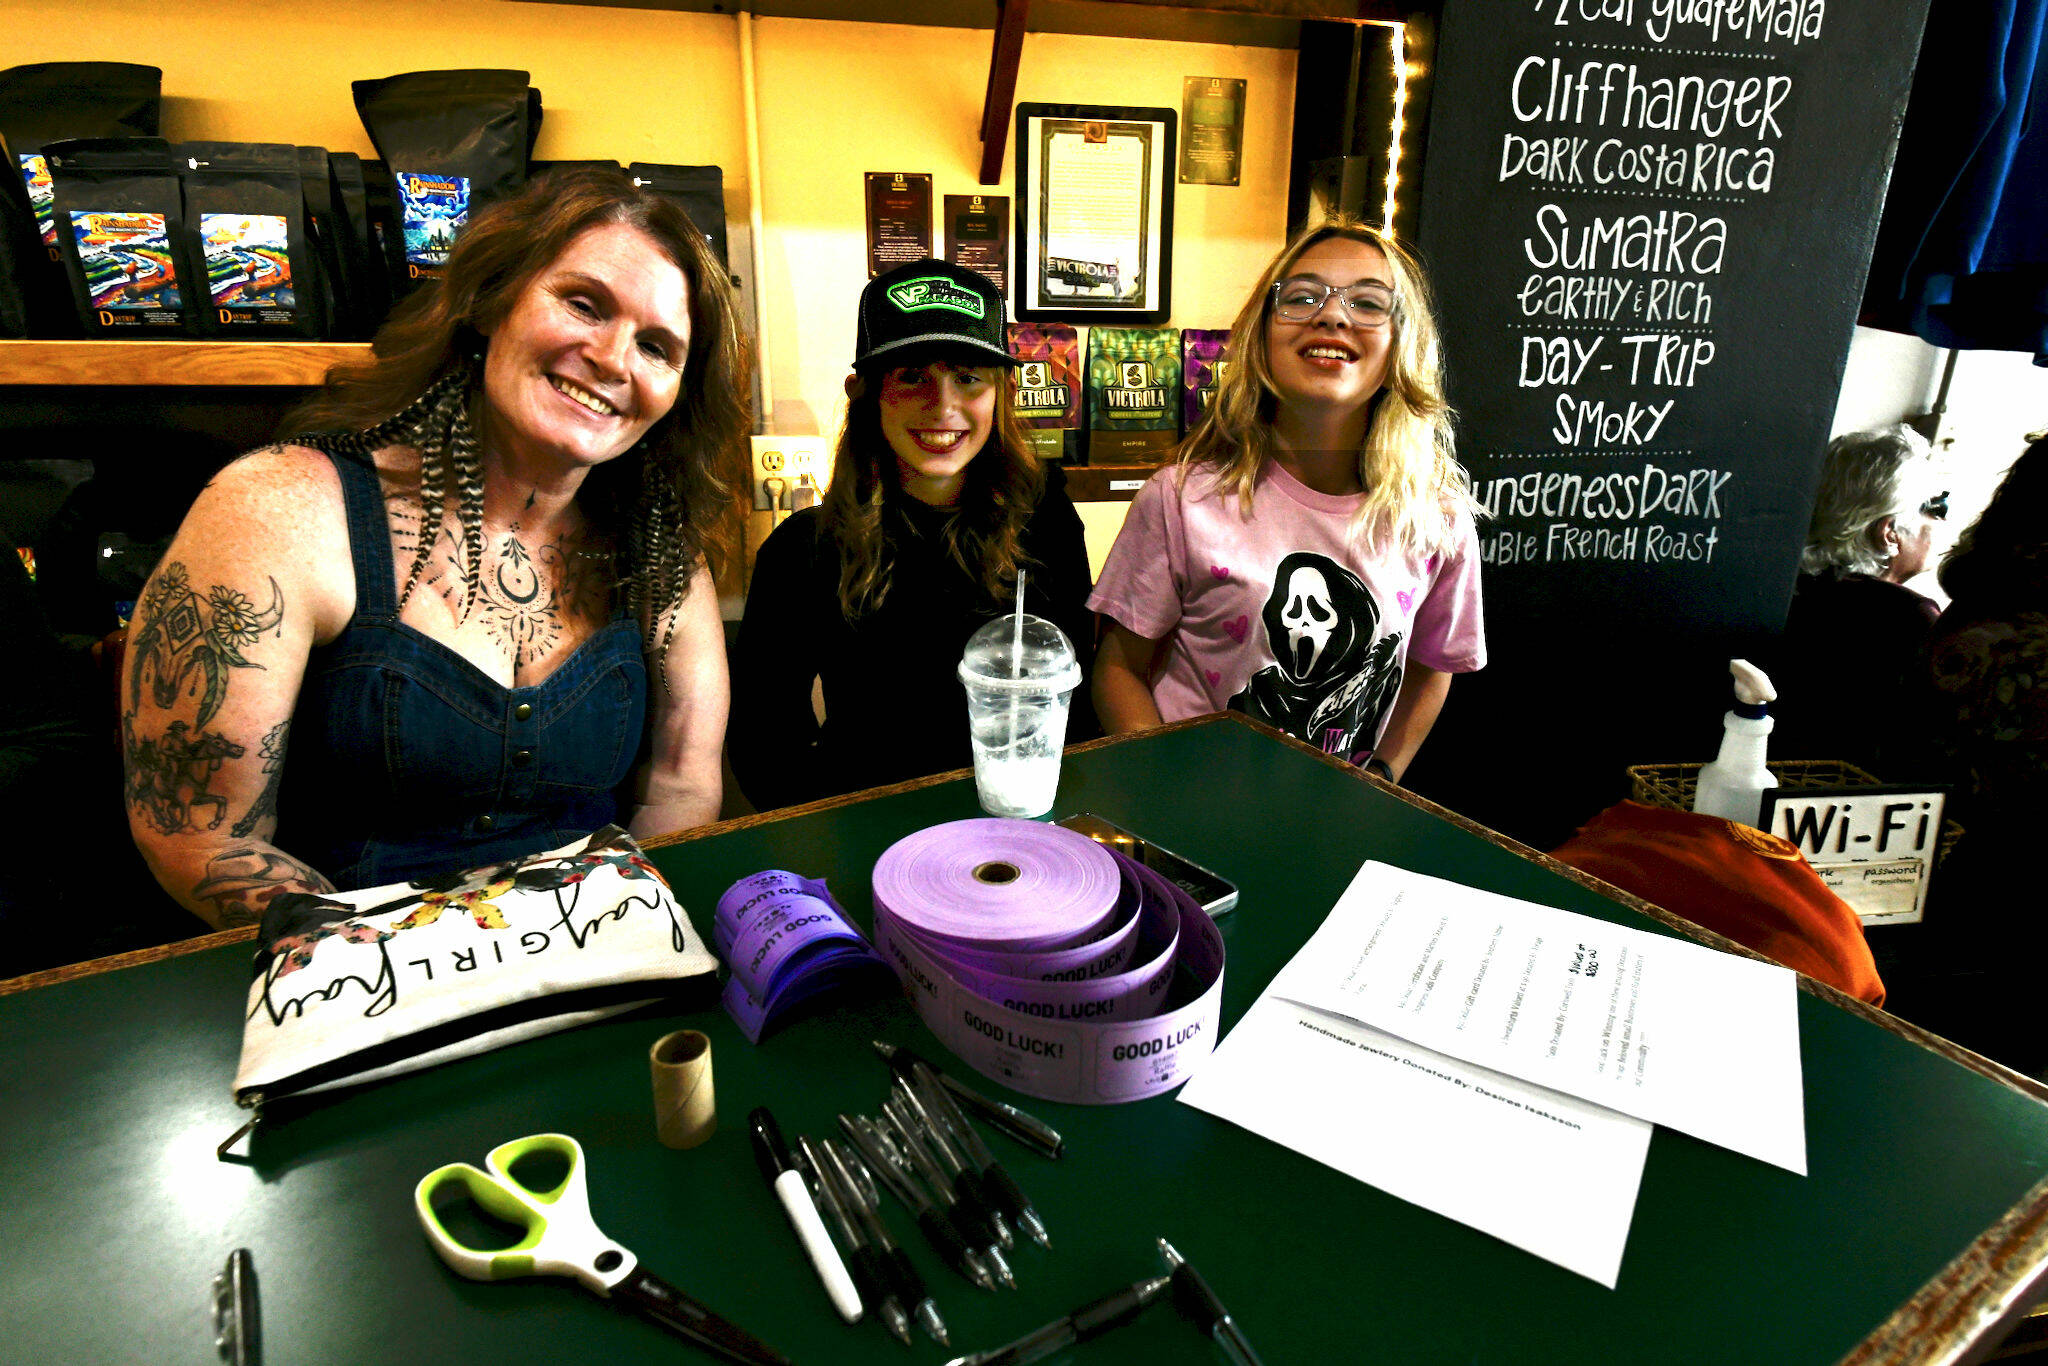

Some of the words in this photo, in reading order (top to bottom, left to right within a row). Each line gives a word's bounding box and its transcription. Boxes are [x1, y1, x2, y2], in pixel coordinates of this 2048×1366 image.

[1056, 260, 1109, 277] VICTROLA
[1014, 388, 1066, 407] ICTROLA
[1107, 389, 1166, 408] VICTROLA
[1784, 802, 1931, 855] Wi-Fi
[1863, 865, 1918, 881] password
[784, 915, 832, 932] GOOD
[408, 931, 552, 981] GIRL
[1059, 999, 1115, 1019] LUCK!
[964, 1010, 1004, 1042] GOOD
[1008, 1031, 1064, 1059] LUCK!
[1112, 1038, 1163, 1061] GOOD
[1299, 1020, 1357, 1047] Handmade
[1402, 1058, 1452, 1082] Donated
[1475, 1086, 1522, 1108] Desiree
